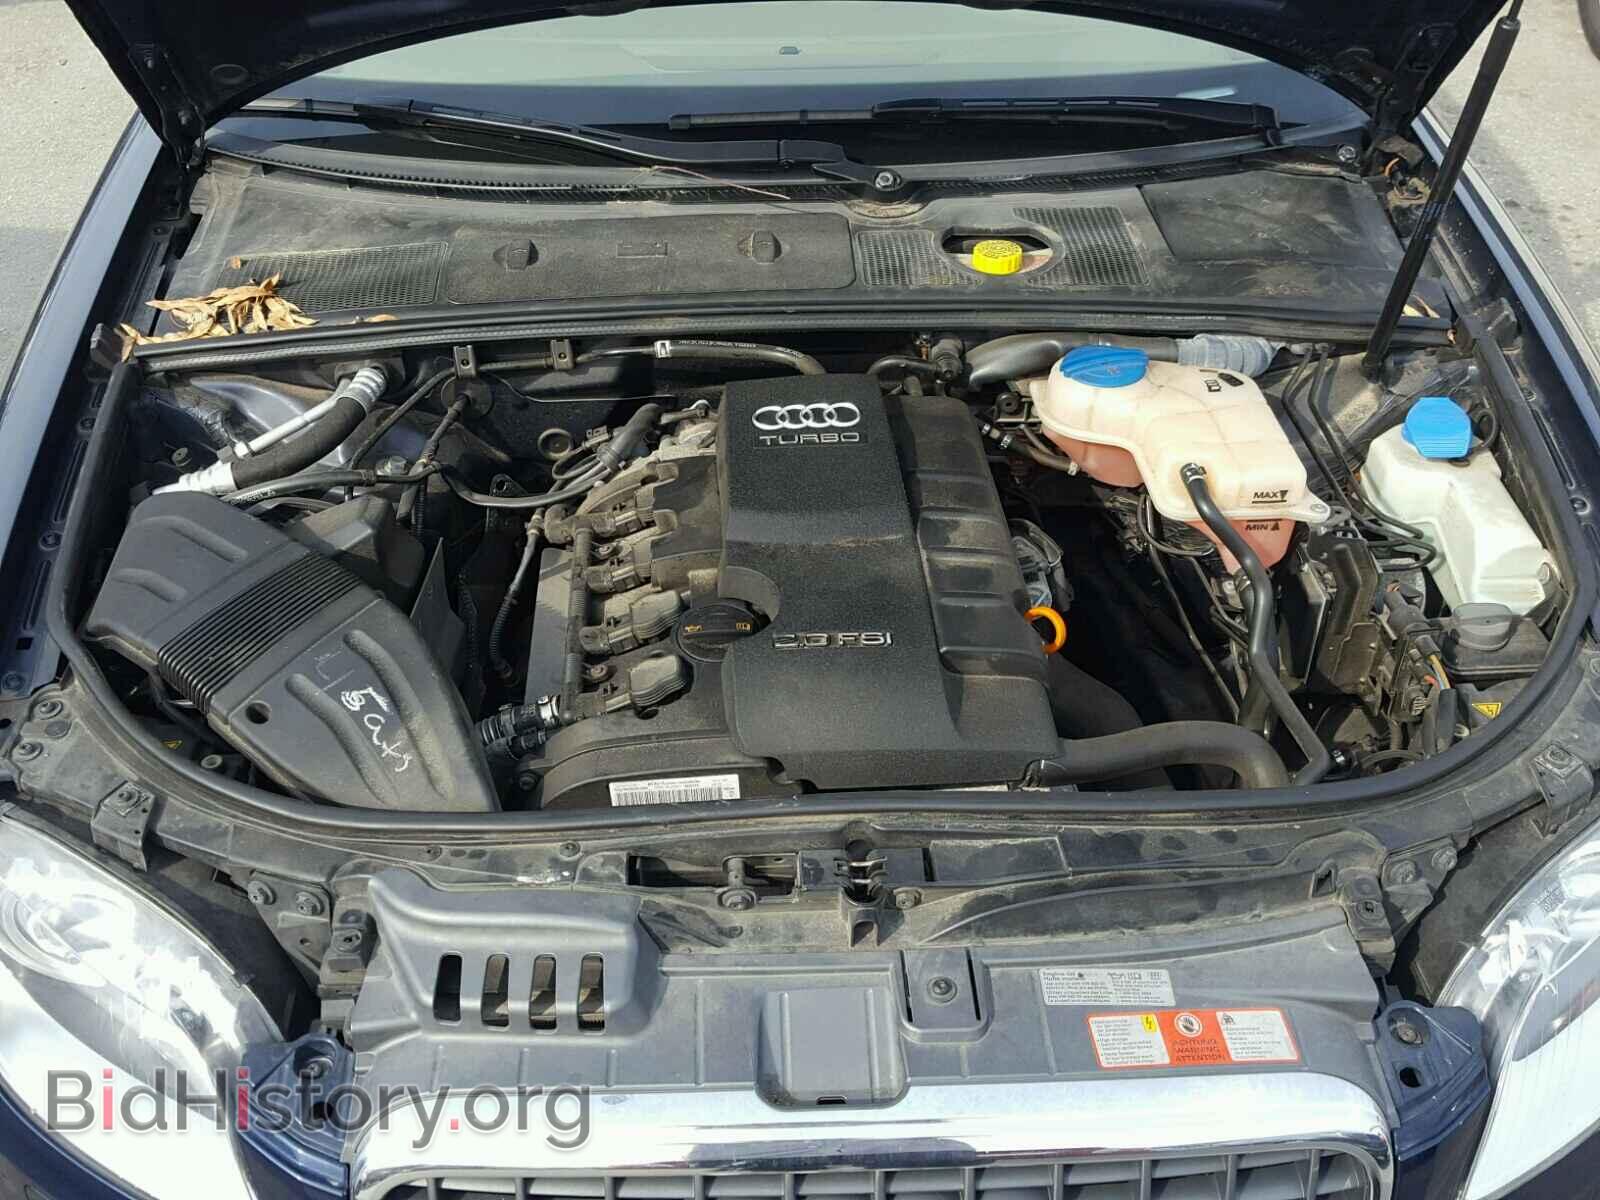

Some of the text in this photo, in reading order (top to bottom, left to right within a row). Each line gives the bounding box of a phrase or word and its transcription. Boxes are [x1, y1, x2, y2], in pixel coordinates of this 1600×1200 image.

[760, 433, 860, 445] TURBO
[1253, 491, 1279, 499] MAX
[1245, 523, 1269, 531] MIN
[839, 631, 893, 647] FSI
[1175, 1054, 1226, 1062] ATTENTION
